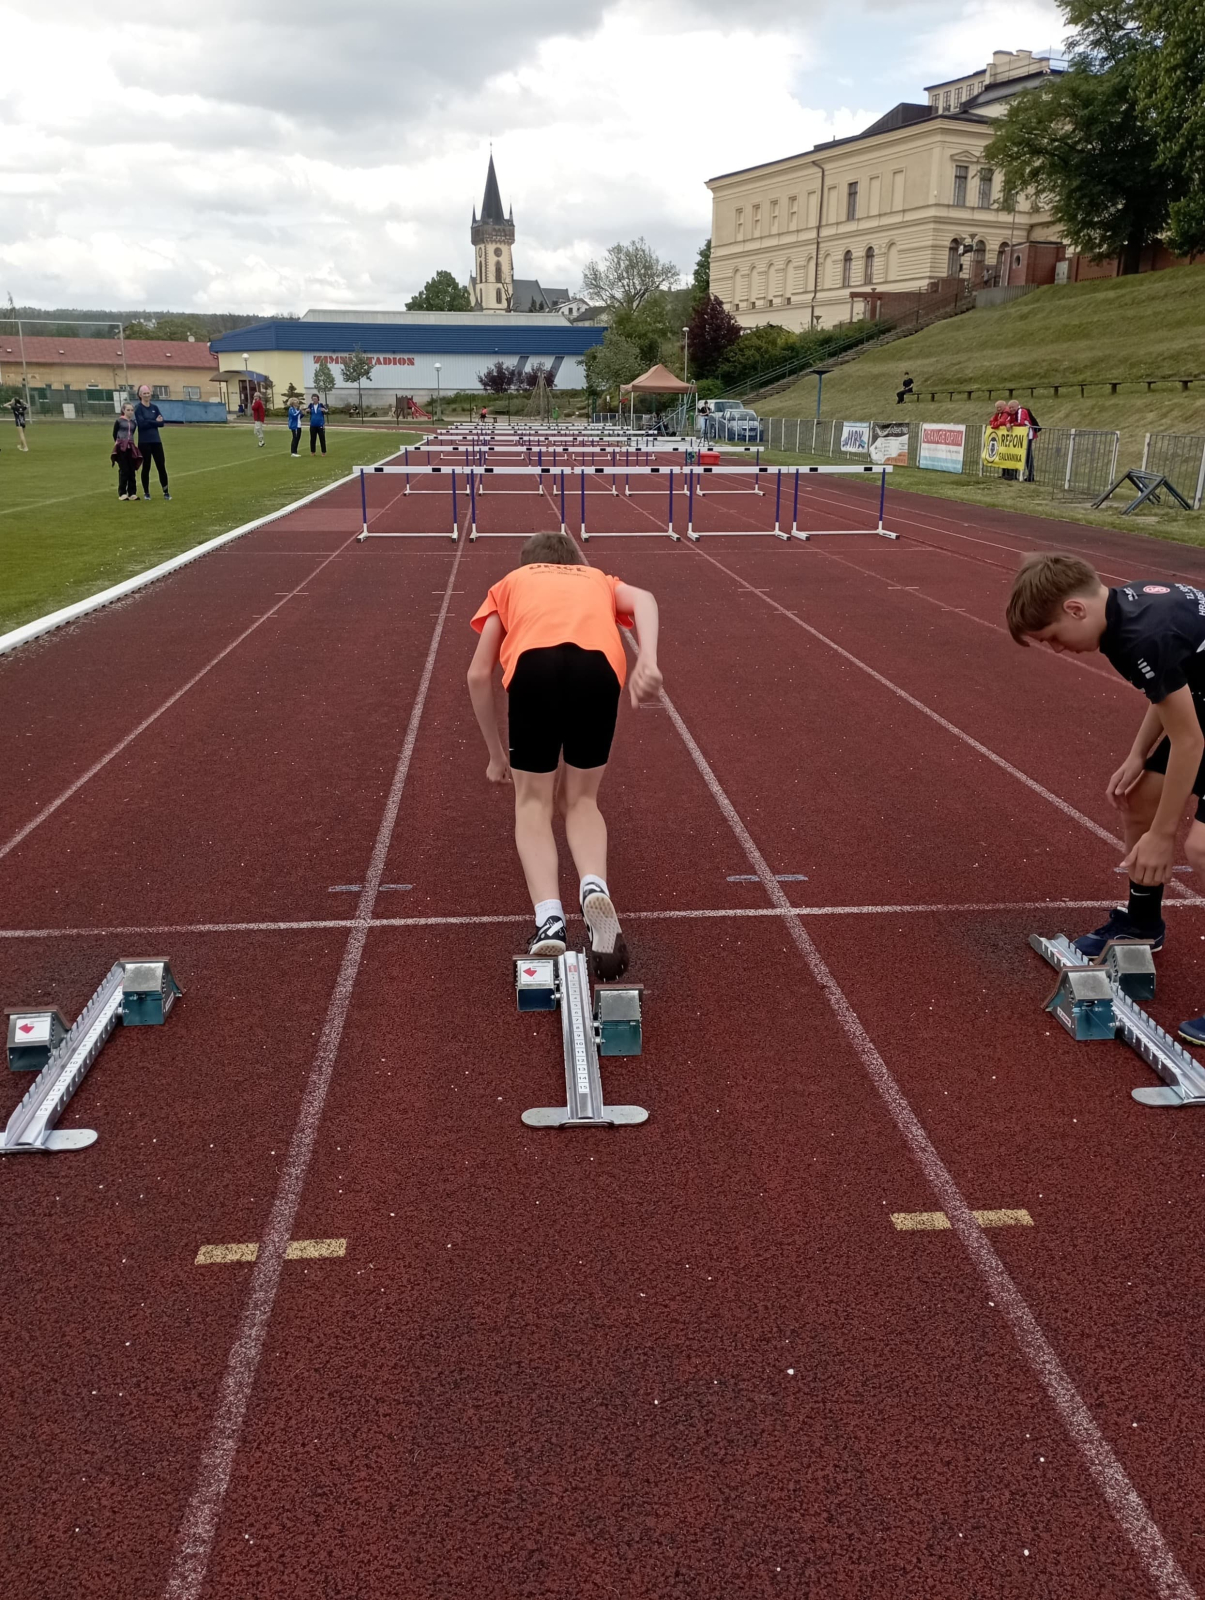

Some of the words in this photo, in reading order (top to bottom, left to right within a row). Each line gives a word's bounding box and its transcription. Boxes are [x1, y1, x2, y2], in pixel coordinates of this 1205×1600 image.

[359, 356, 415, 366] TADION
[924, 430, 945, 443] ORANGE
[1001, 434, 1024, 449] REPON
[998, 453, 1022, 462] GALVANIKA
